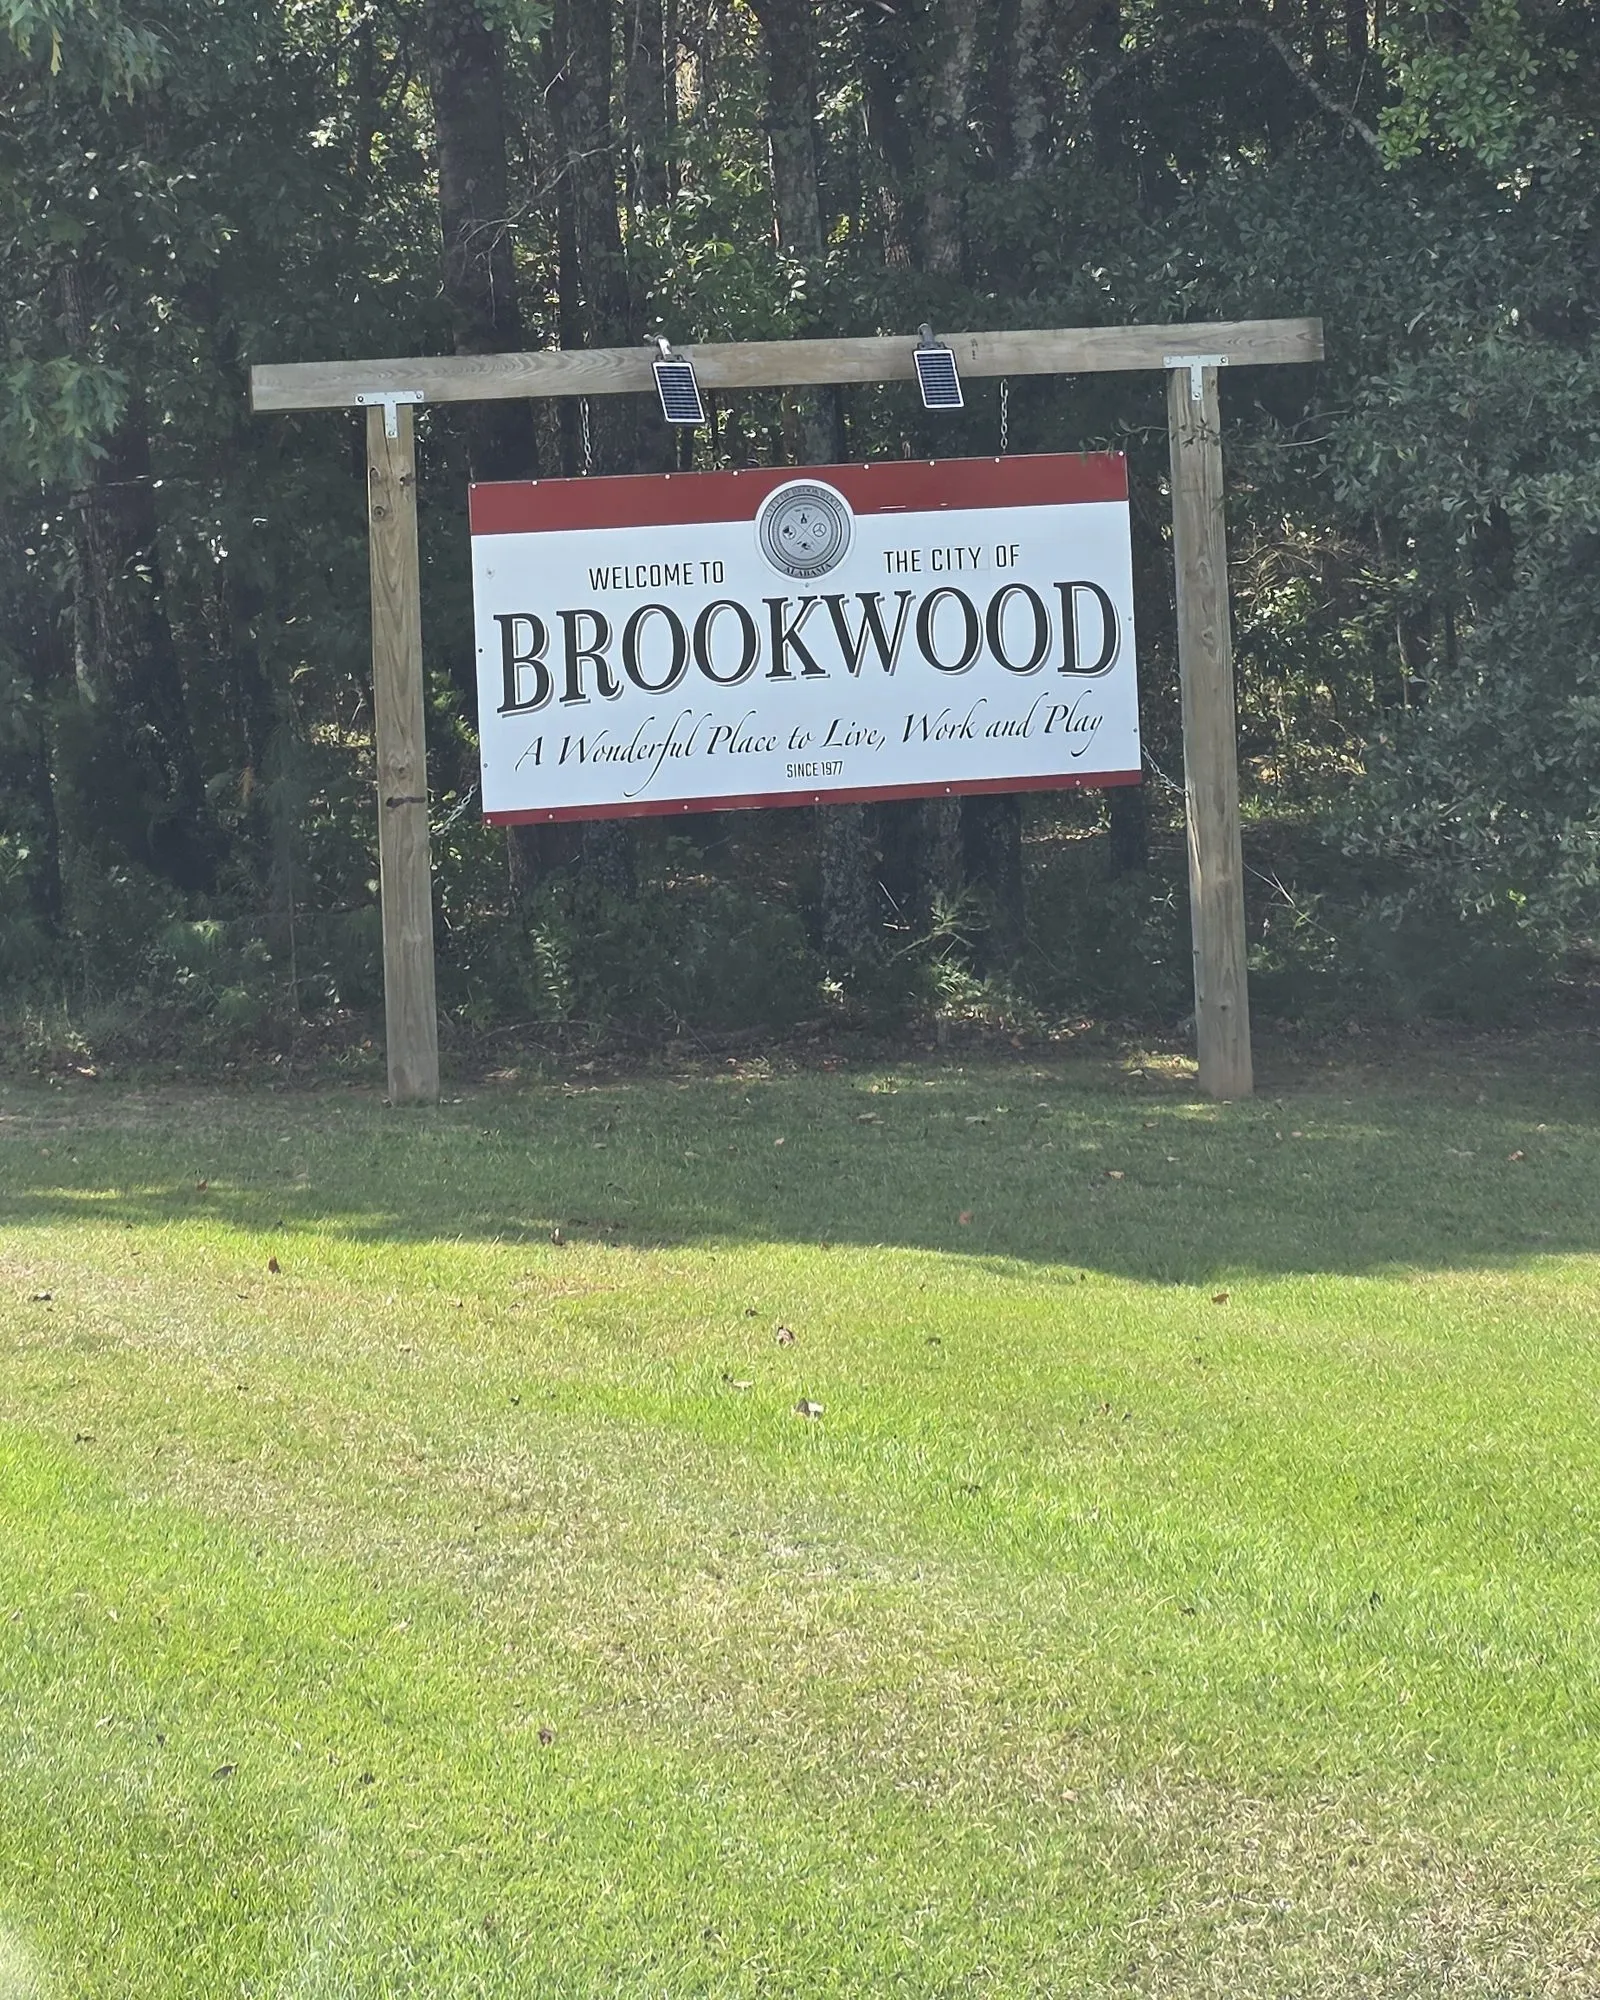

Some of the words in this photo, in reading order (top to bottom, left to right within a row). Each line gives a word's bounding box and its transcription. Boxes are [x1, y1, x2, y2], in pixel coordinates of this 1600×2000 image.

[785, 563, 832, 578] ALABAMA
[882, 549, 922, 574] THE
[931, 546, 983, 573] CITY
[995, 543, 1020, 569] OF
[588, 562, 694, 590] WELCOME
[698, 560, 724, 585] TO
[493, 580, 1122, 719] BROOKWOOD
[514, 735, 543, 772] A
[557, 709, 712, 797] Wonderful
[706, 710, 780, 755] Place
[787, 725, 814, 750] to
[820, 717, 886, 752] Live,
[902, 698, 988, 743] Work
[985, 691, 1049, 739] and
[1043, 689, 1104, 757] Play
[786, 762, 819, 779] SINCE
[820, 760, 843, 776] 1977
